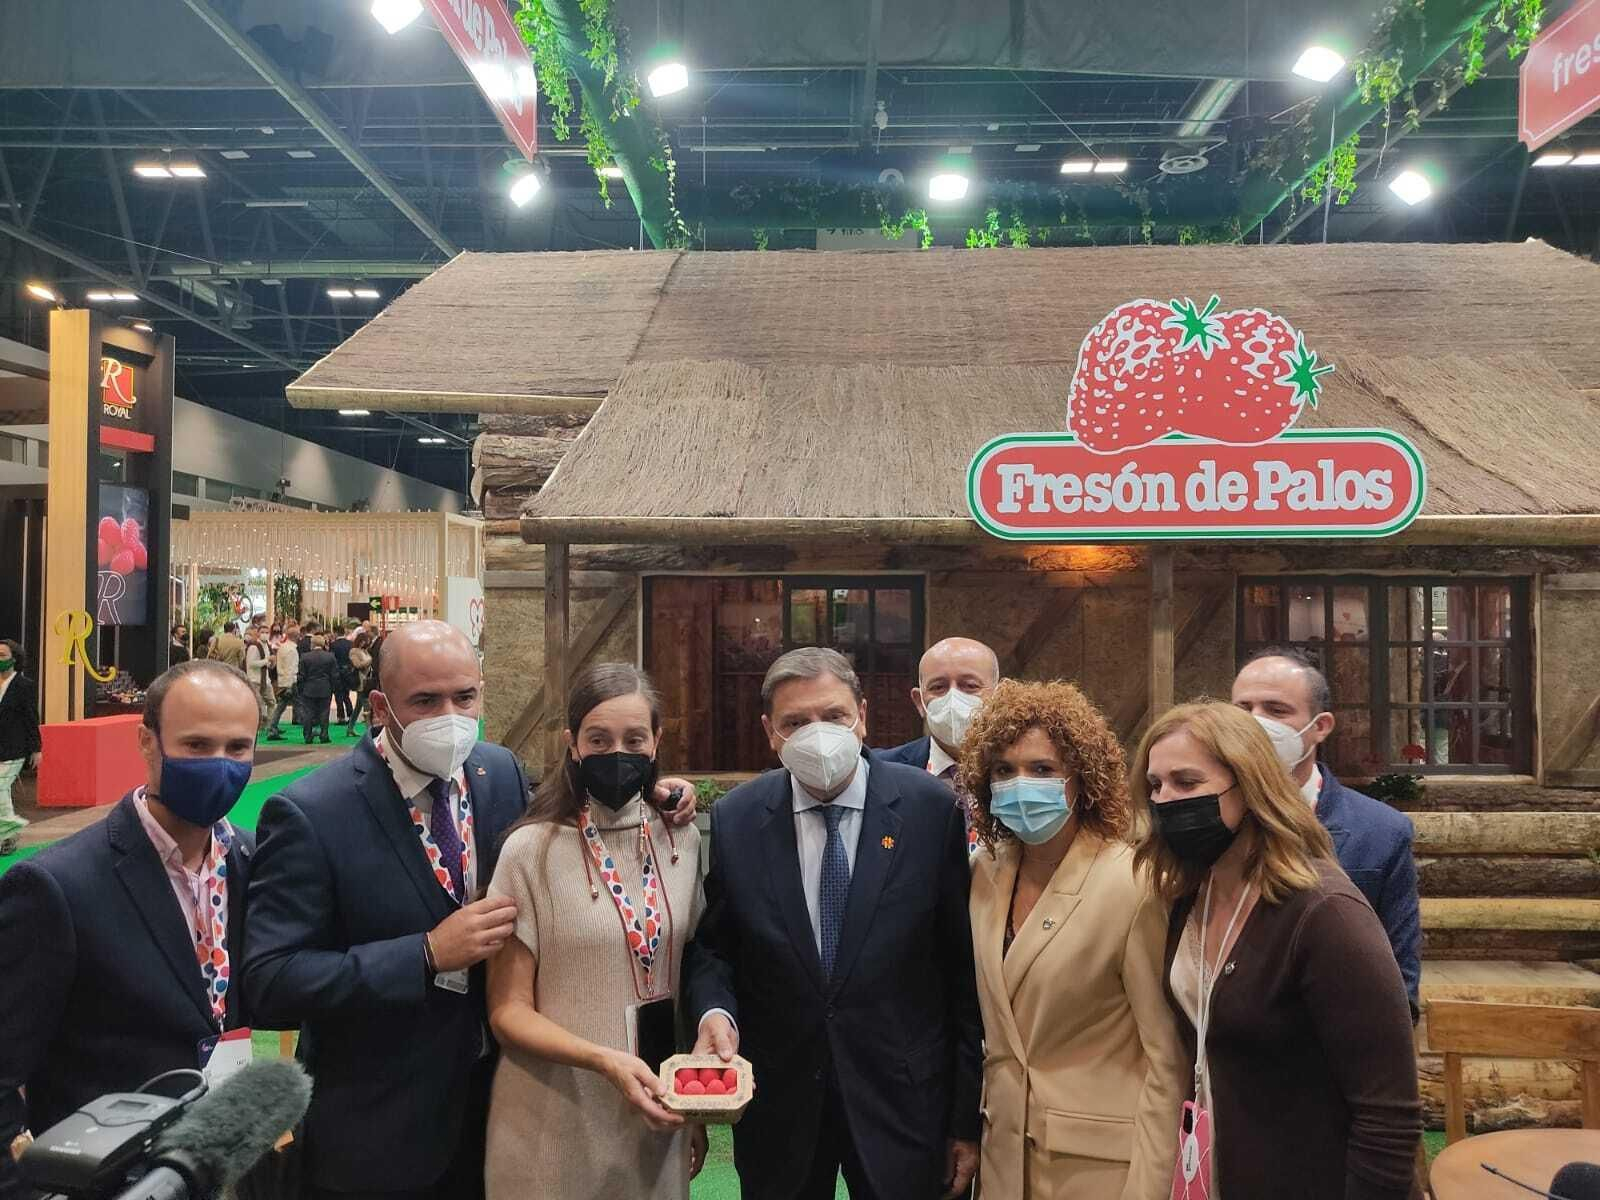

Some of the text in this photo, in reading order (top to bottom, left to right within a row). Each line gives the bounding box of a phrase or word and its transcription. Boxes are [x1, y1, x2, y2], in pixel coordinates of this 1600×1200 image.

[100, 356, 137, 404] R
[103, 403, 132, 420] ROYAL
[997, 459, 1393, 513] Fresón de Palos
[54, 608, 118, 682] R
